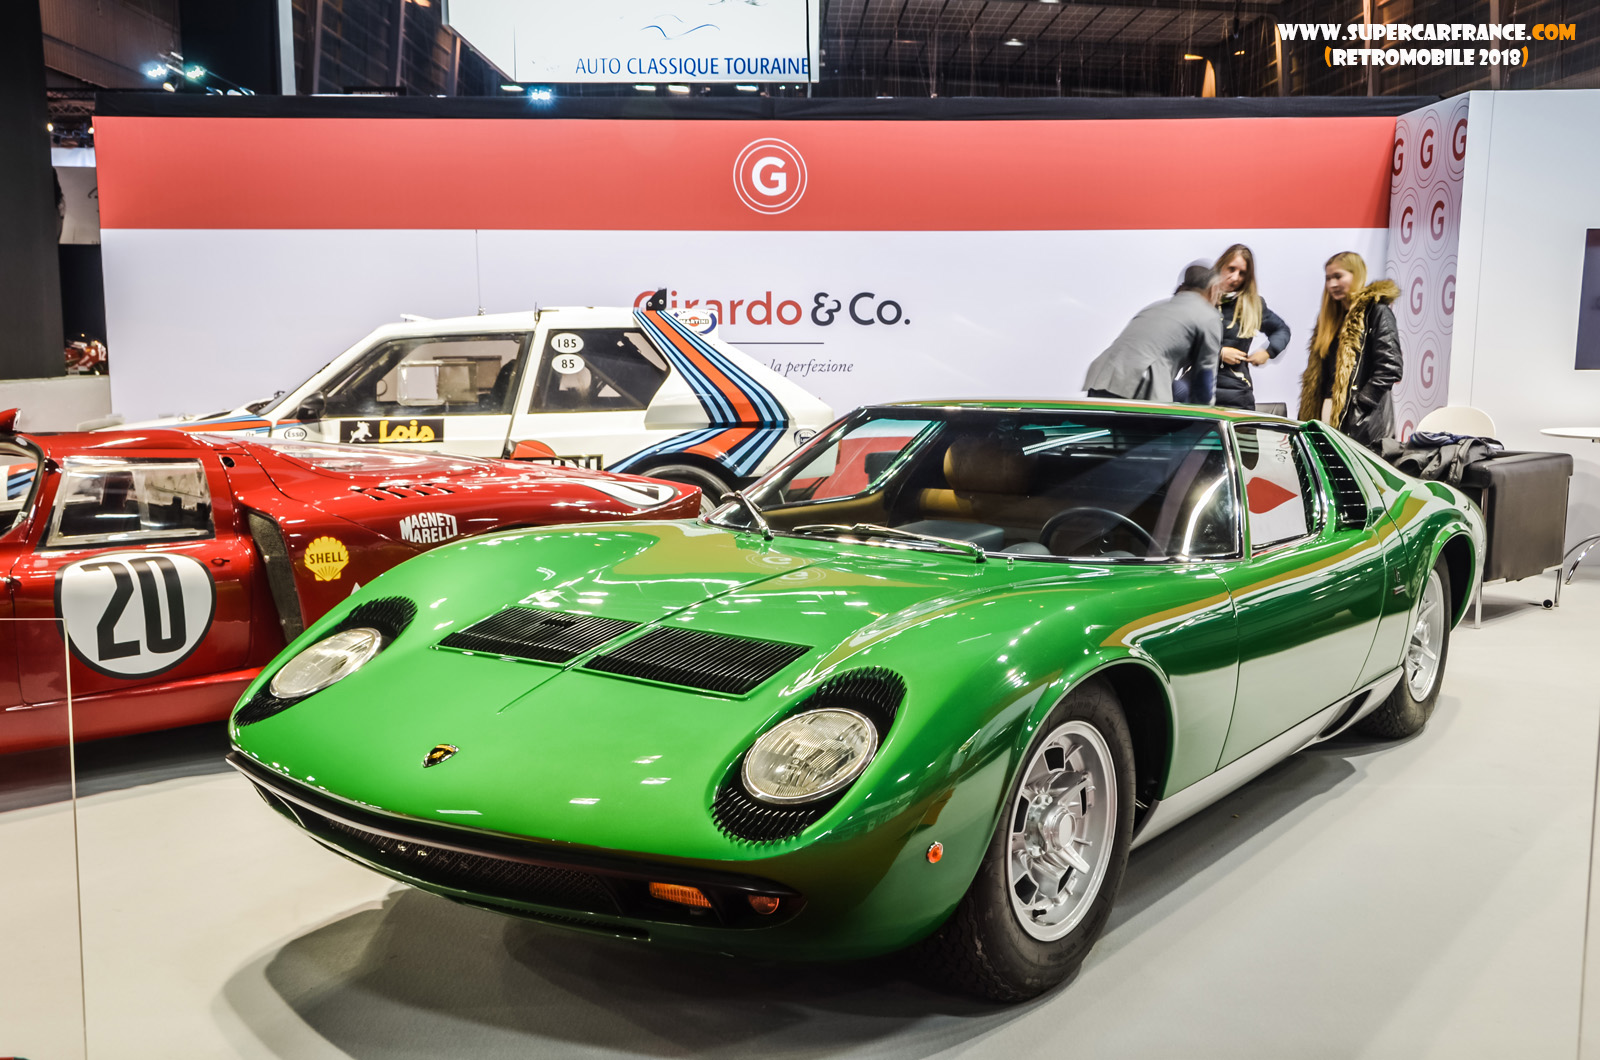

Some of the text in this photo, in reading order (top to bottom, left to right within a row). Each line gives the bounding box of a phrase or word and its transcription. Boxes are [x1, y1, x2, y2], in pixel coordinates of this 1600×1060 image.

[575, 57, 809, 77] AUTO CLASSIQUE TOURAINE
[1393, 118, 1468, 176] G G G
[752, 156, 787, 196] G
[1401, 200, 1445, 245] G G
[811, 291, 842, 326] &
[848, 291, 911, 326] Co.
[1410, 274, 1456, 315] G G
[557, 338, 577, 349] 185
[561, 359, 575, 369] 85
[770, 358, 854, 377] la perfezione
[1420, 350, 1435, 389] G
[379, 419, 436, 443] Lois
[400, 522, 458, 544] MARELLI
[309, 551, 344, 564] SHELL
[80, 556, 187, 662] 20
